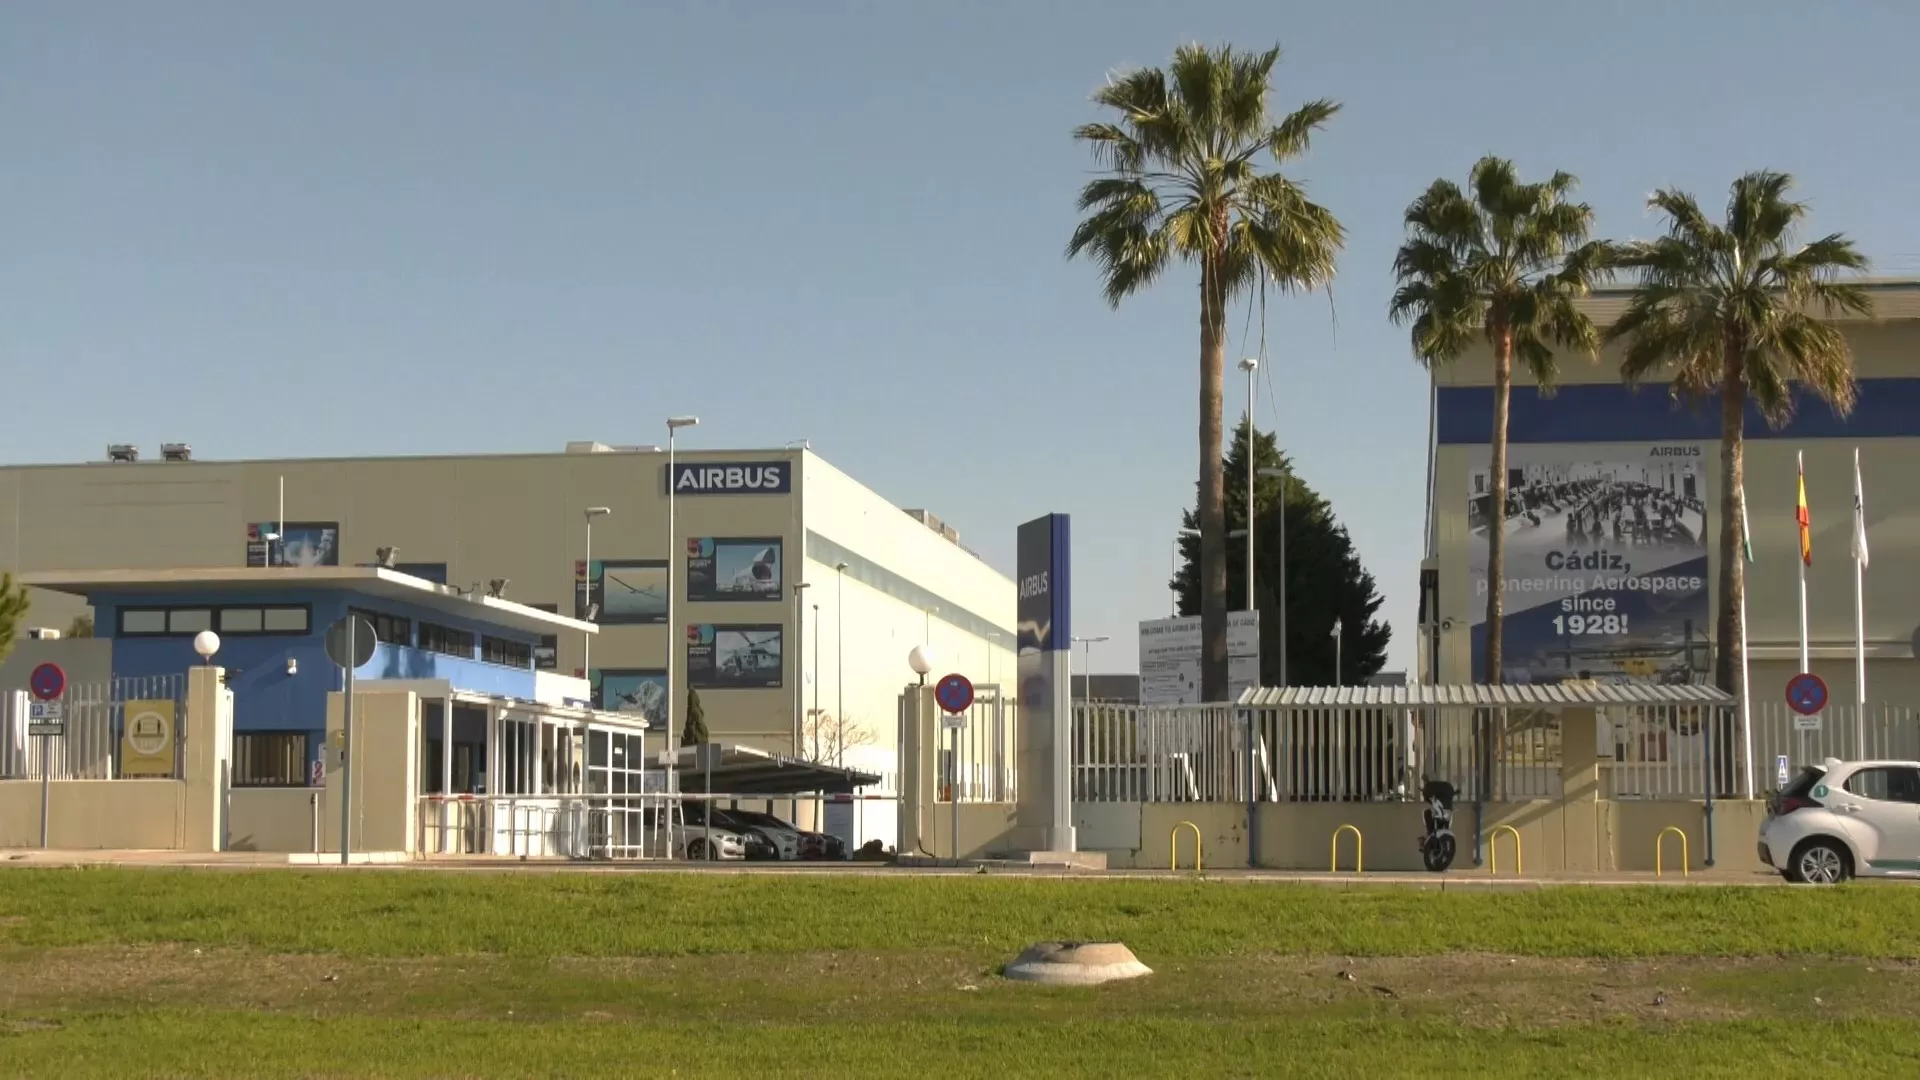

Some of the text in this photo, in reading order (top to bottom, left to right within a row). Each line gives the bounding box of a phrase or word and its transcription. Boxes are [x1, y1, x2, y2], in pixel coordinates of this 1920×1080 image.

[1649, 446, 1700, 457] AIRBUS
[677, 467, 780, 490] AIRBUS
[1545, 550, 1631, 573] Cádiz,
[1020, 570, 1048, 600] AIRBUS
[1476, 574, 1701, 596] pneering Aerospace
[1561, 596, 1616, 612] since
[1552, 614, 1629, 635] 1928!
